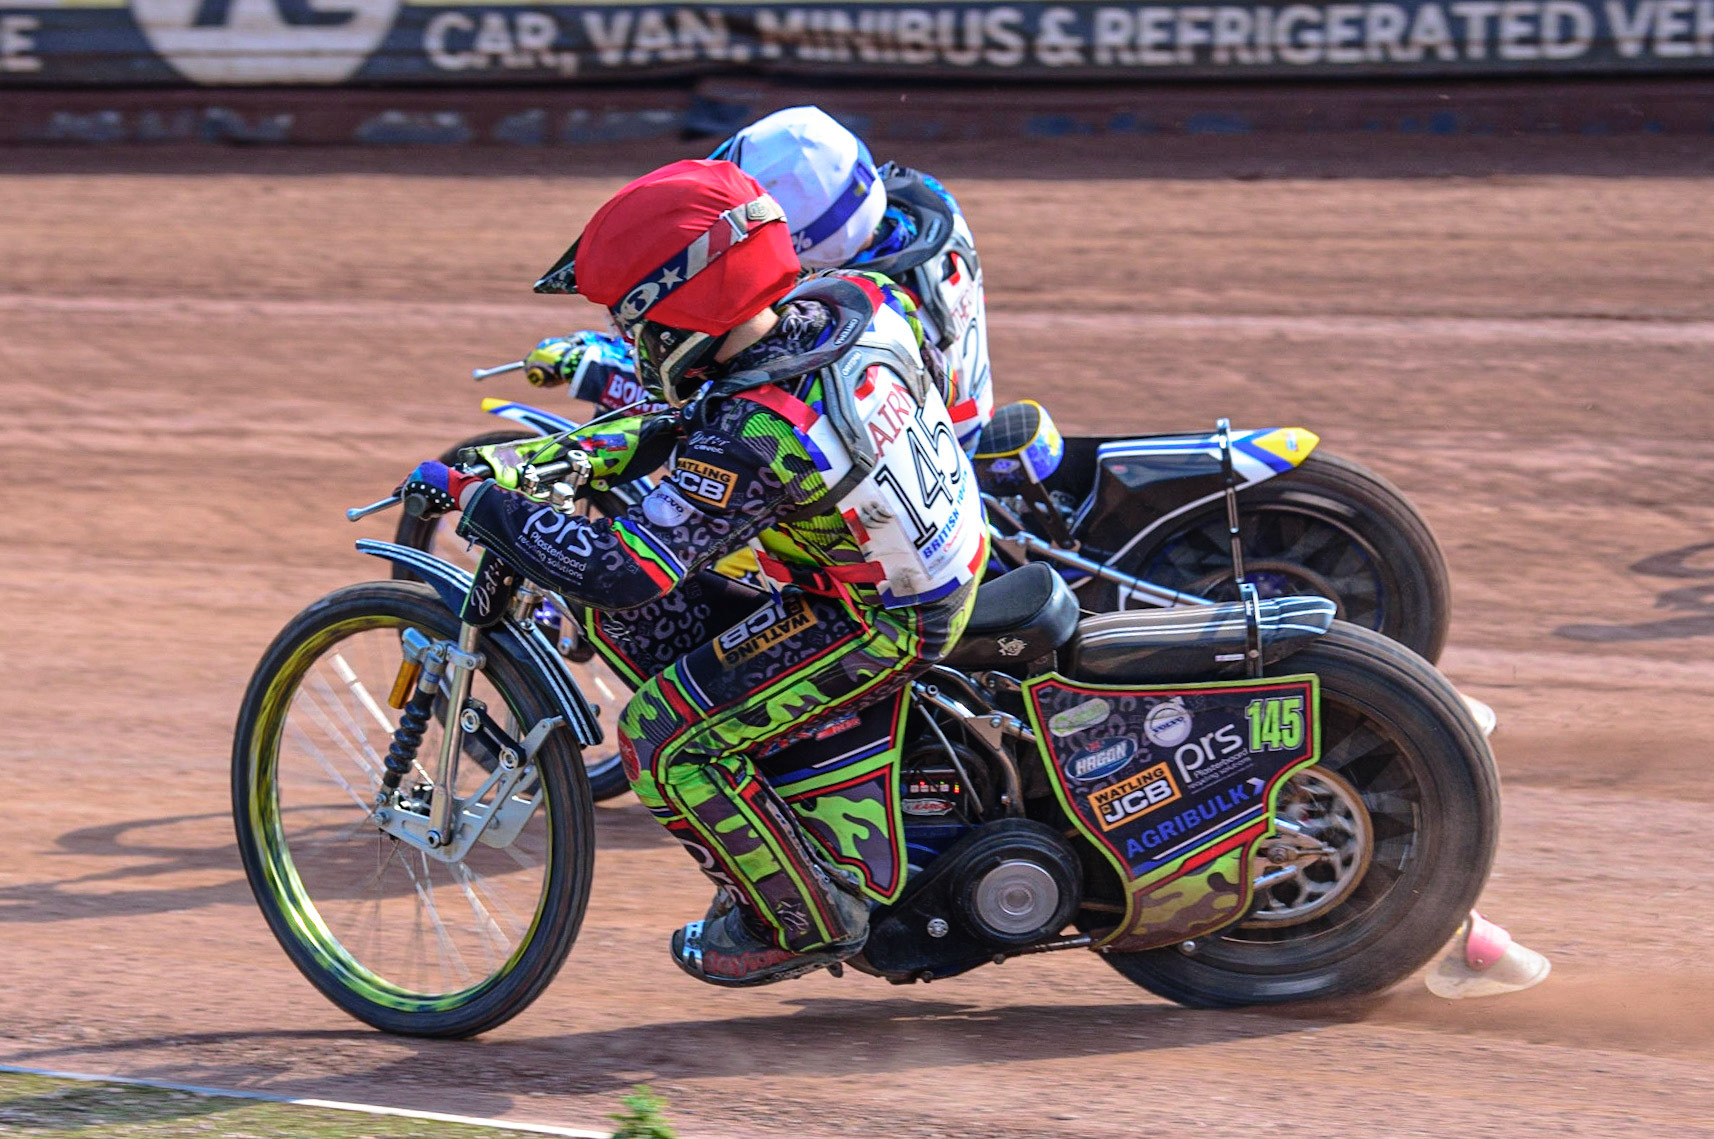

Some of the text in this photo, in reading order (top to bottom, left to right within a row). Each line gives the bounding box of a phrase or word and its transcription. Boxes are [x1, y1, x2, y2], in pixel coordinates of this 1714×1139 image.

[424, 11, 578, 76] CAR,
[1034, 8, 1084, 66] &
[1095, 4, 1594, 65] REFRIGERATED
[873, 404, 961, 551] 145
[522, 506, 599, 558] prs
[530, 531, 587, 572] Plasterboard
[723, 612, 812, 667] WATLING
[1245, 696, 1305, 753] 145
[1074, 741, 1129, 778] HAGON
[1174, 723, 1243, 784] prs
[1094, 766, 1166, 804] WATLING
[1103, 779, 1173, 823] JCB
[1125, 784, 1251, 859] AGRIBULK
